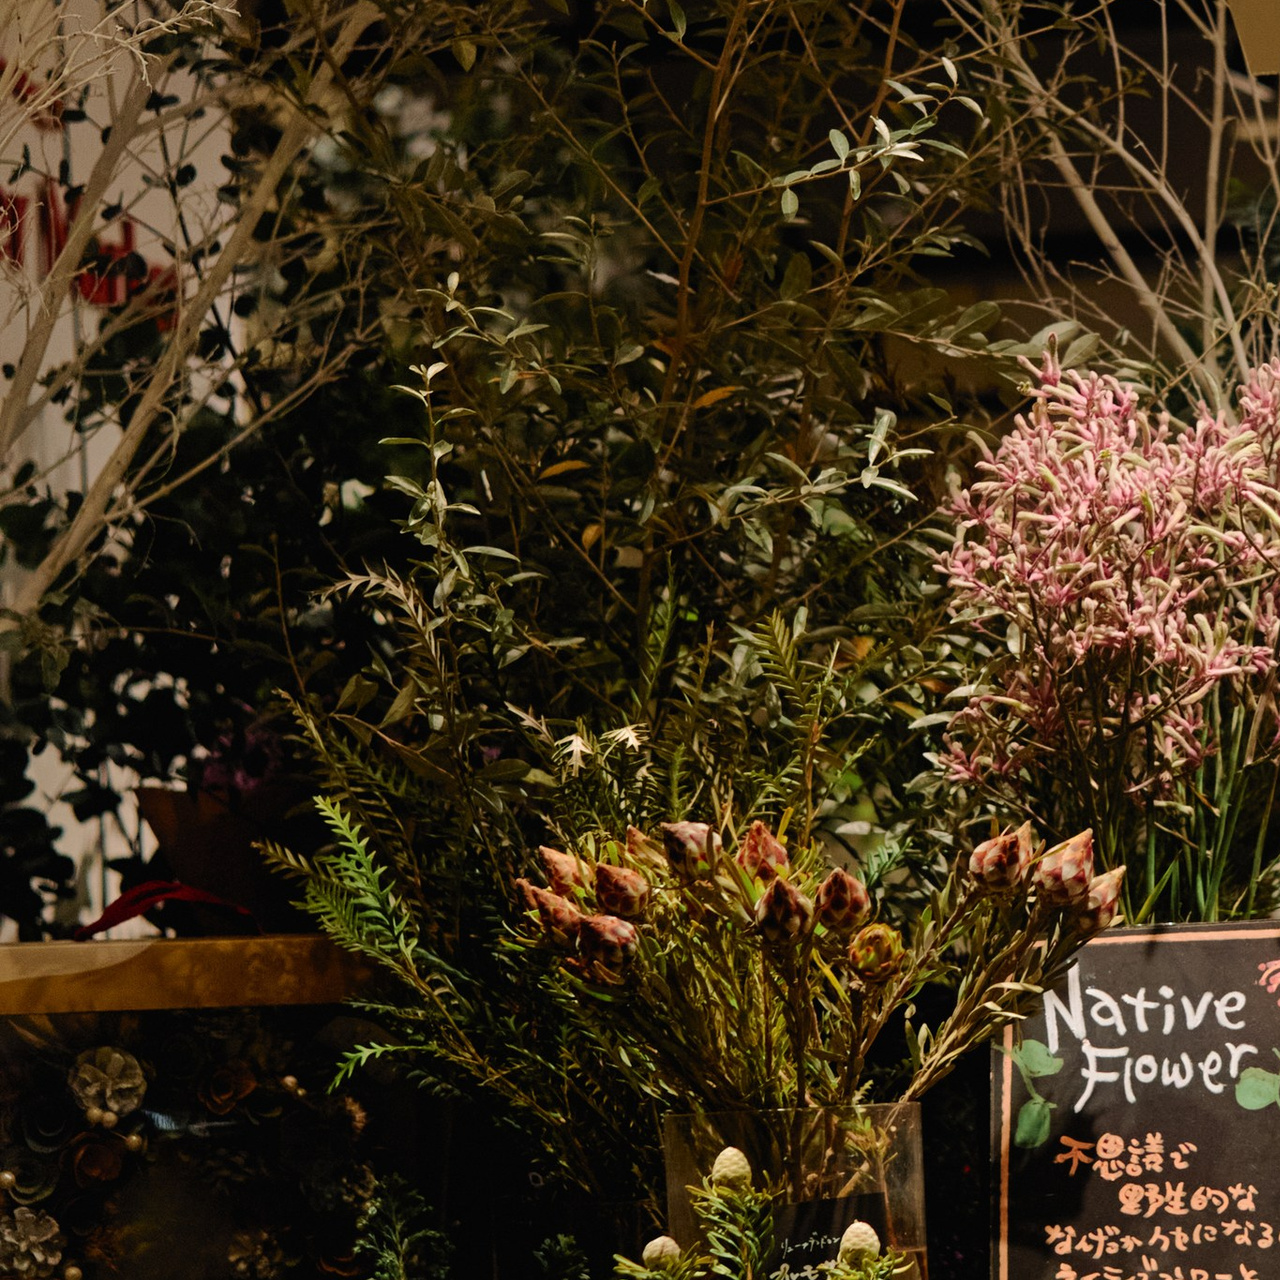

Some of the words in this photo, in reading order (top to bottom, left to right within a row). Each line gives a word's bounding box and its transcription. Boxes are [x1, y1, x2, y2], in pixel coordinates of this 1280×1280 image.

[1043, 957, 1247, 1054] Native
[1073, 1038, 1259, 1114] Flower
[1053, 1131, 1198, 1181] 不思議で
[1118, 1182, 1259, 1218] 野生的な
